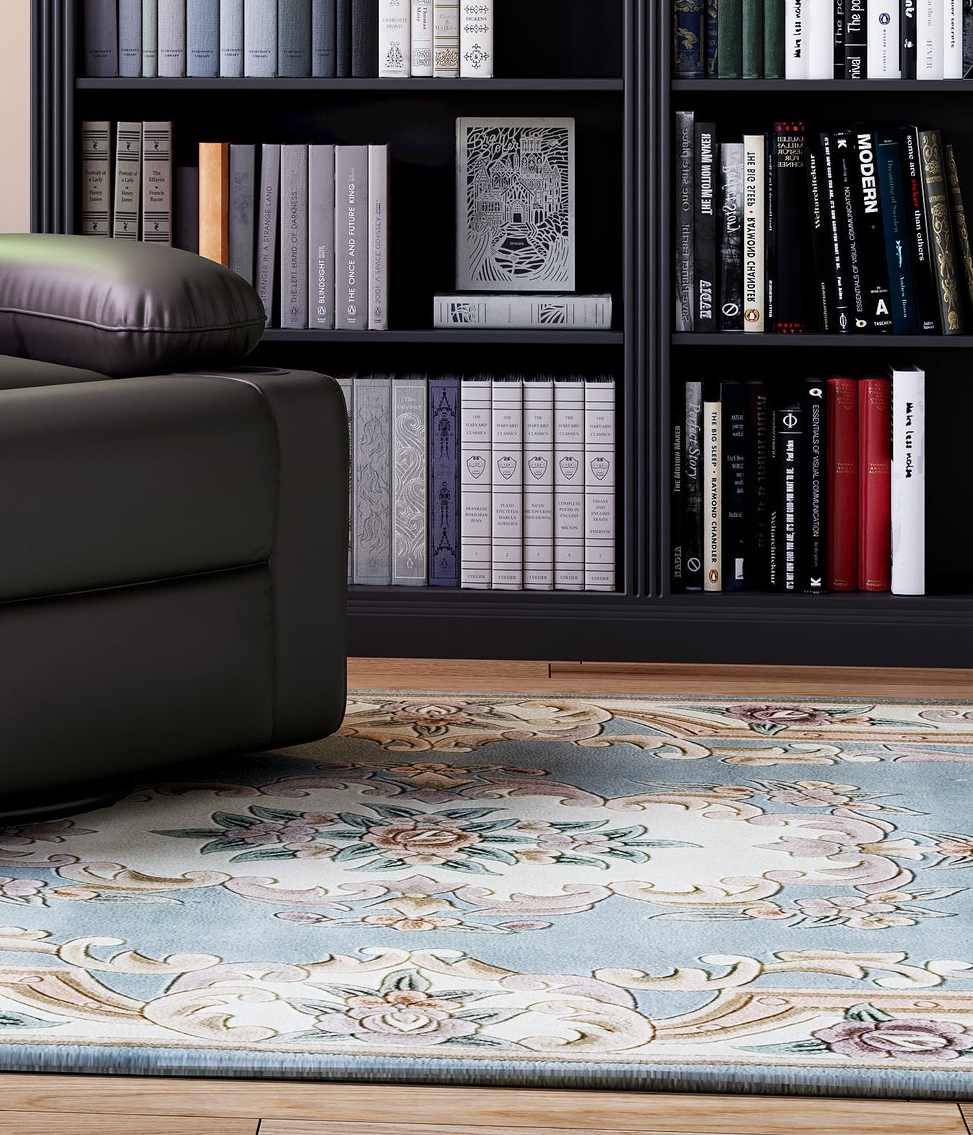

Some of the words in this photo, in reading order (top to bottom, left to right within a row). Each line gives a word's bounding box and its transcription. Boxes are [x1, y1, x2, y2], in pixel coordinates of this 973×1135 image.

[835, 20, 843, 46] The
[847, 14, 861, 33] The
[857, 133, 878, 214] MODERN
[348, 183, 356, 204] KING
[810, 153, 821, 229] Weltarchitektur
[911, 178, 919, 208] sicker
[263, 208, 272, 243] STRANGE
[348, 206, 356, 236] FUTURE
[914, 209, 923, 231] than
[263, 244, 269, 252] A
[291, 232, 298, 242] OF
[348, 238, 356, 257] AND
[916, 232, 925, 262] others
[262, 254, 268, 262] IN
[348, 260, 356, 285] ONCE
[348, 288, 356, 303] THE
[876, 299, 889, 315] A
[686, 403, 701, 445] Perfect
[812, 404, 820, 445] ESSENTIALS
[685, 445, 701, 480] Story
[812, 445, 820, 455] OF
[812, 455, 820, 480] VISUAL
[812, 480, 820, 537] COMMUNICATION
